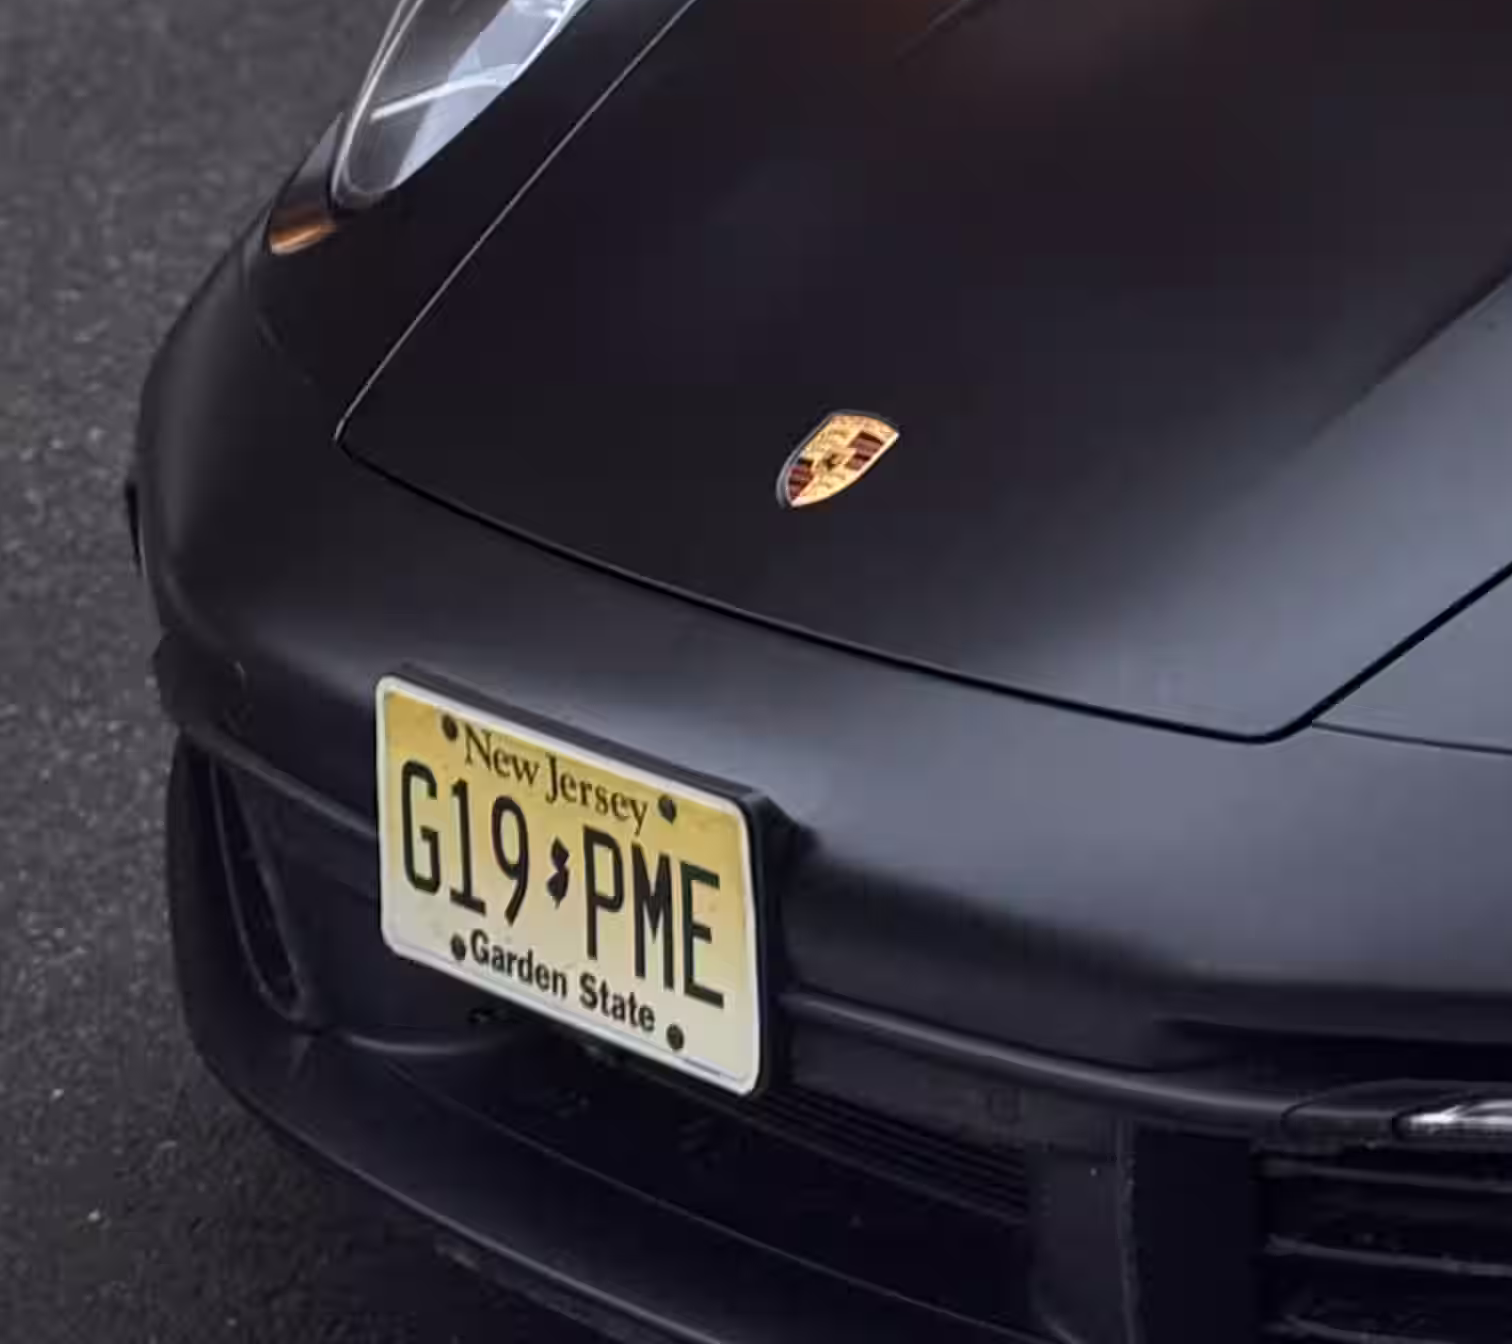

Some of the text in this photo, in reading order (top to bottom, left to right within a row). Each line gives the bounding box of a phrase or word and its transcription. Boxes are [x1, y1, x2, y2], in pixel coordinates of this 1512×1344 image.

[464, 724, 649, 835] New Jersey
[401, 760, 725, 1009] G19 PME
[469, 928, 656, 1033] Garden State
